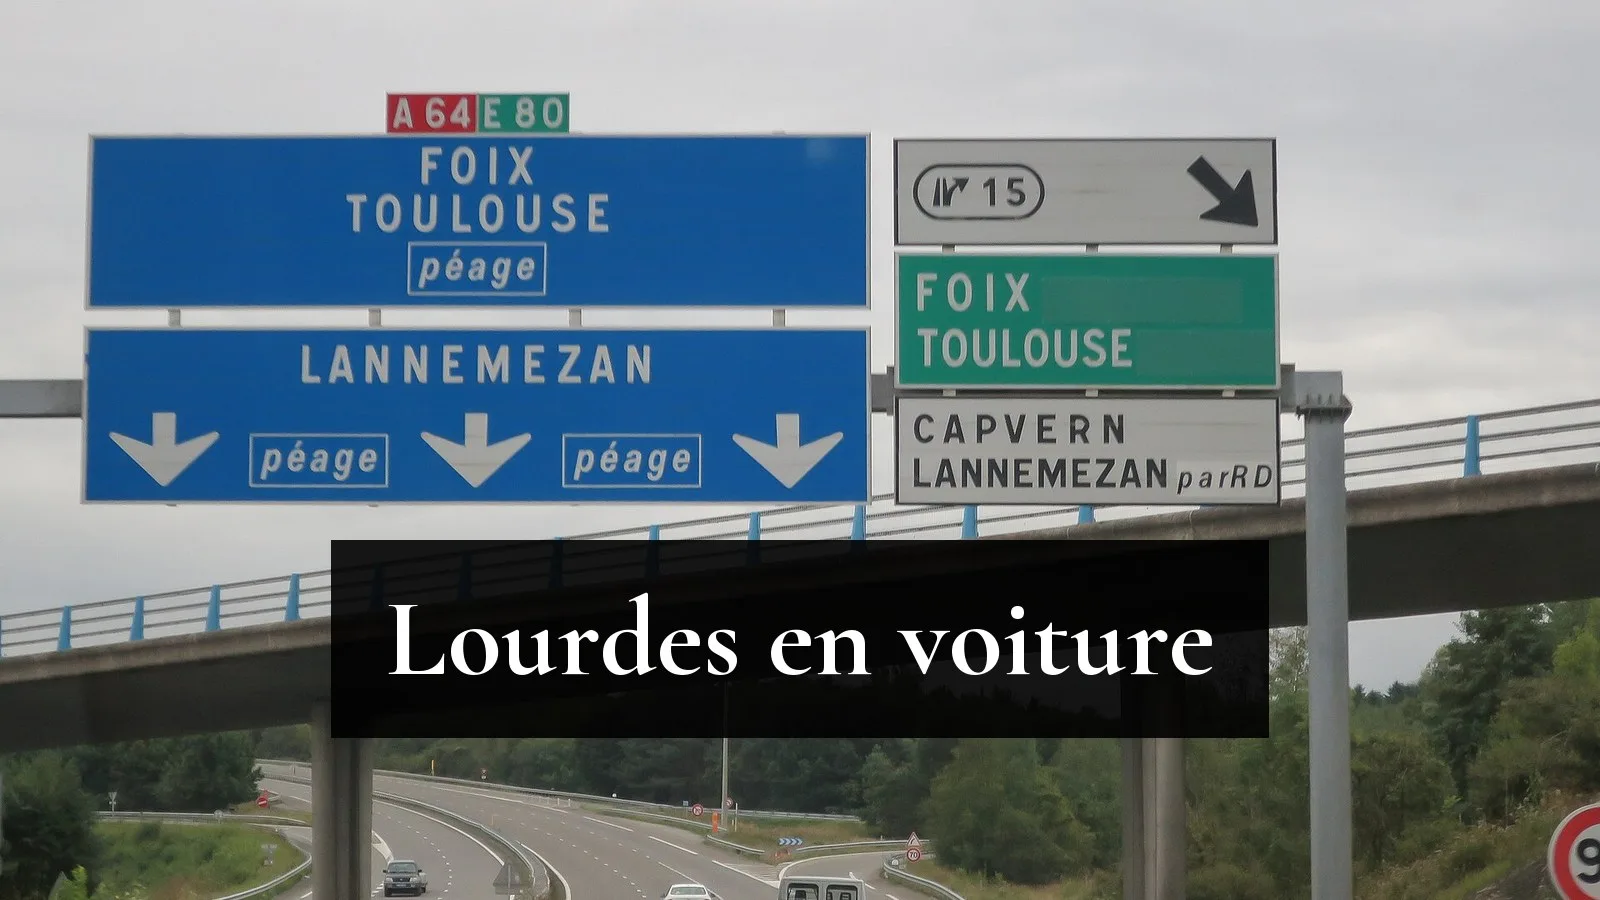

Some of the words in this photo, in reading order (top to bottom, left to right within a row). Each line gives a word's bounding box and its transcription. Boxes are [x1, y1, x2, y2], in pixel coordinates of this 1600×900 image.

[393, 97, 413, 128] A
[425, 97, 471, 128] 64
[484, 97, 501, 128] E
[515, 97, 563, 128] 80
[421, 145, 533, 186] FOIX
[982, 177, 1026, 207] 15
[346, 193, 609, 234] TOULOUSE
[418, 248, 535, 290] péage
[916, 272, 1030, 312] FOIX
[301, 344, 651, 384] LANNEMEZAN
[917, 327, 1133, 368] TOULOUSE
[913, 413, 1124, 444] CAPVERN
[259, 440, 378, 481] péage
[573, 440, 691, 481] péage
[913, 457, 1167, 488] LANNEMEZAN
